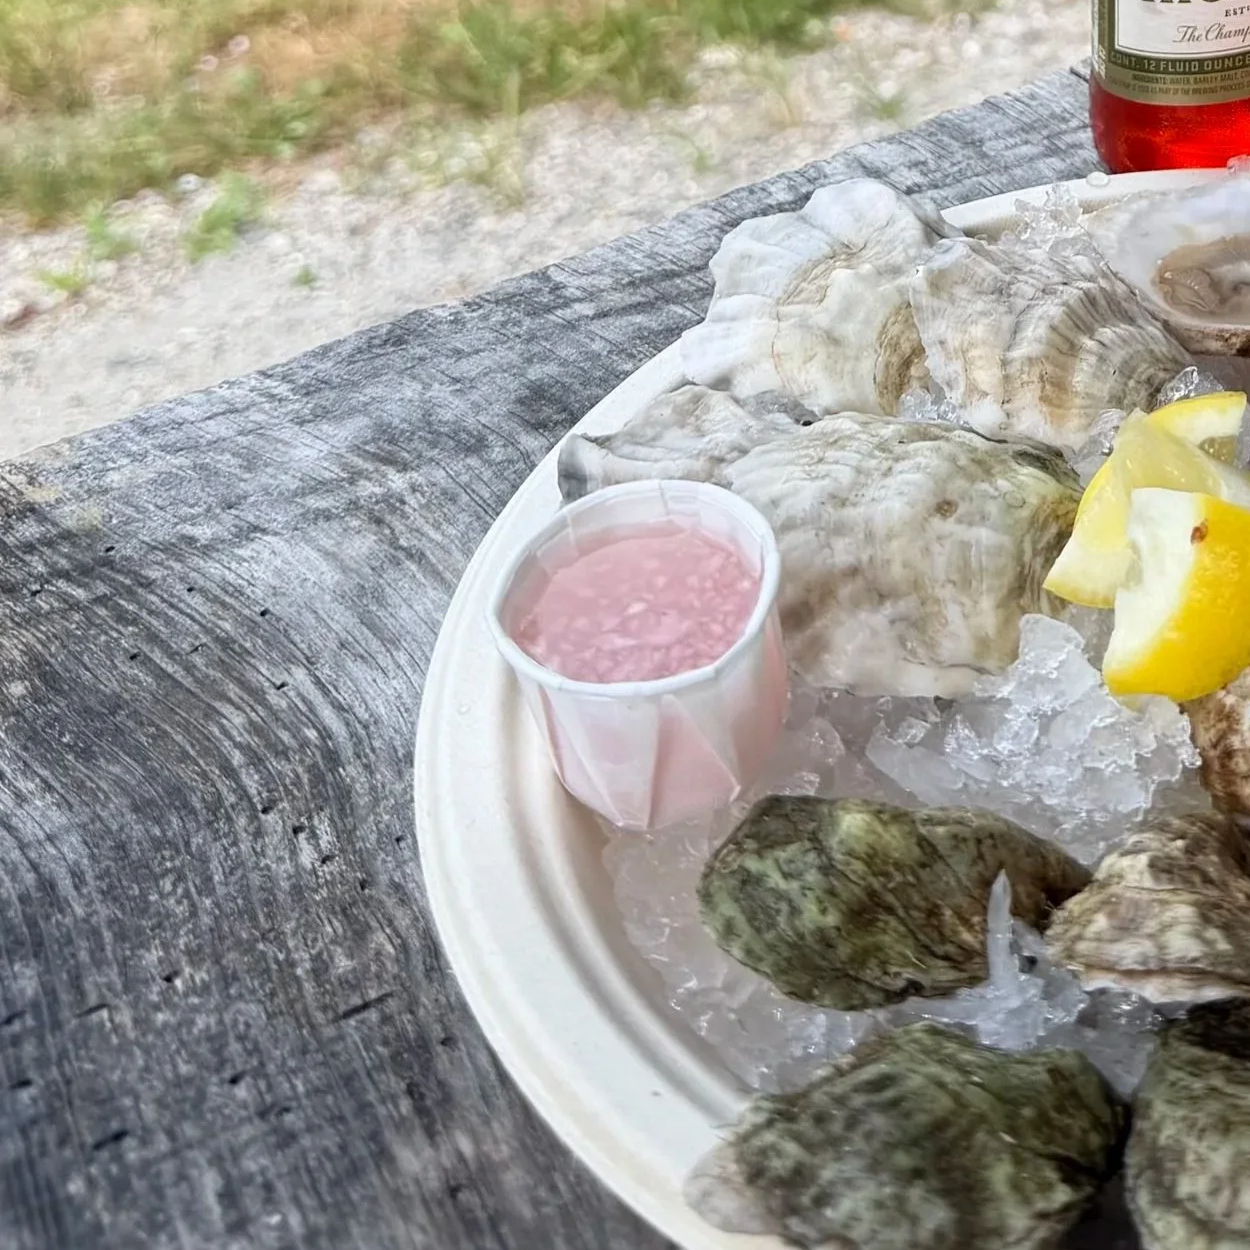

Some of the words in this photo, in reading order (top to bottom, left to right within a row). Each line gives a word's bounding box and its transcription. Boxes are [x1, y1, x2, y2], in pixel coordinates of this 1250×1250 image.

[1172, 24, 1203, 43] The
[1143, 59, 1156, 71] 12
[1160, 61, 1199, 72] FLUID
